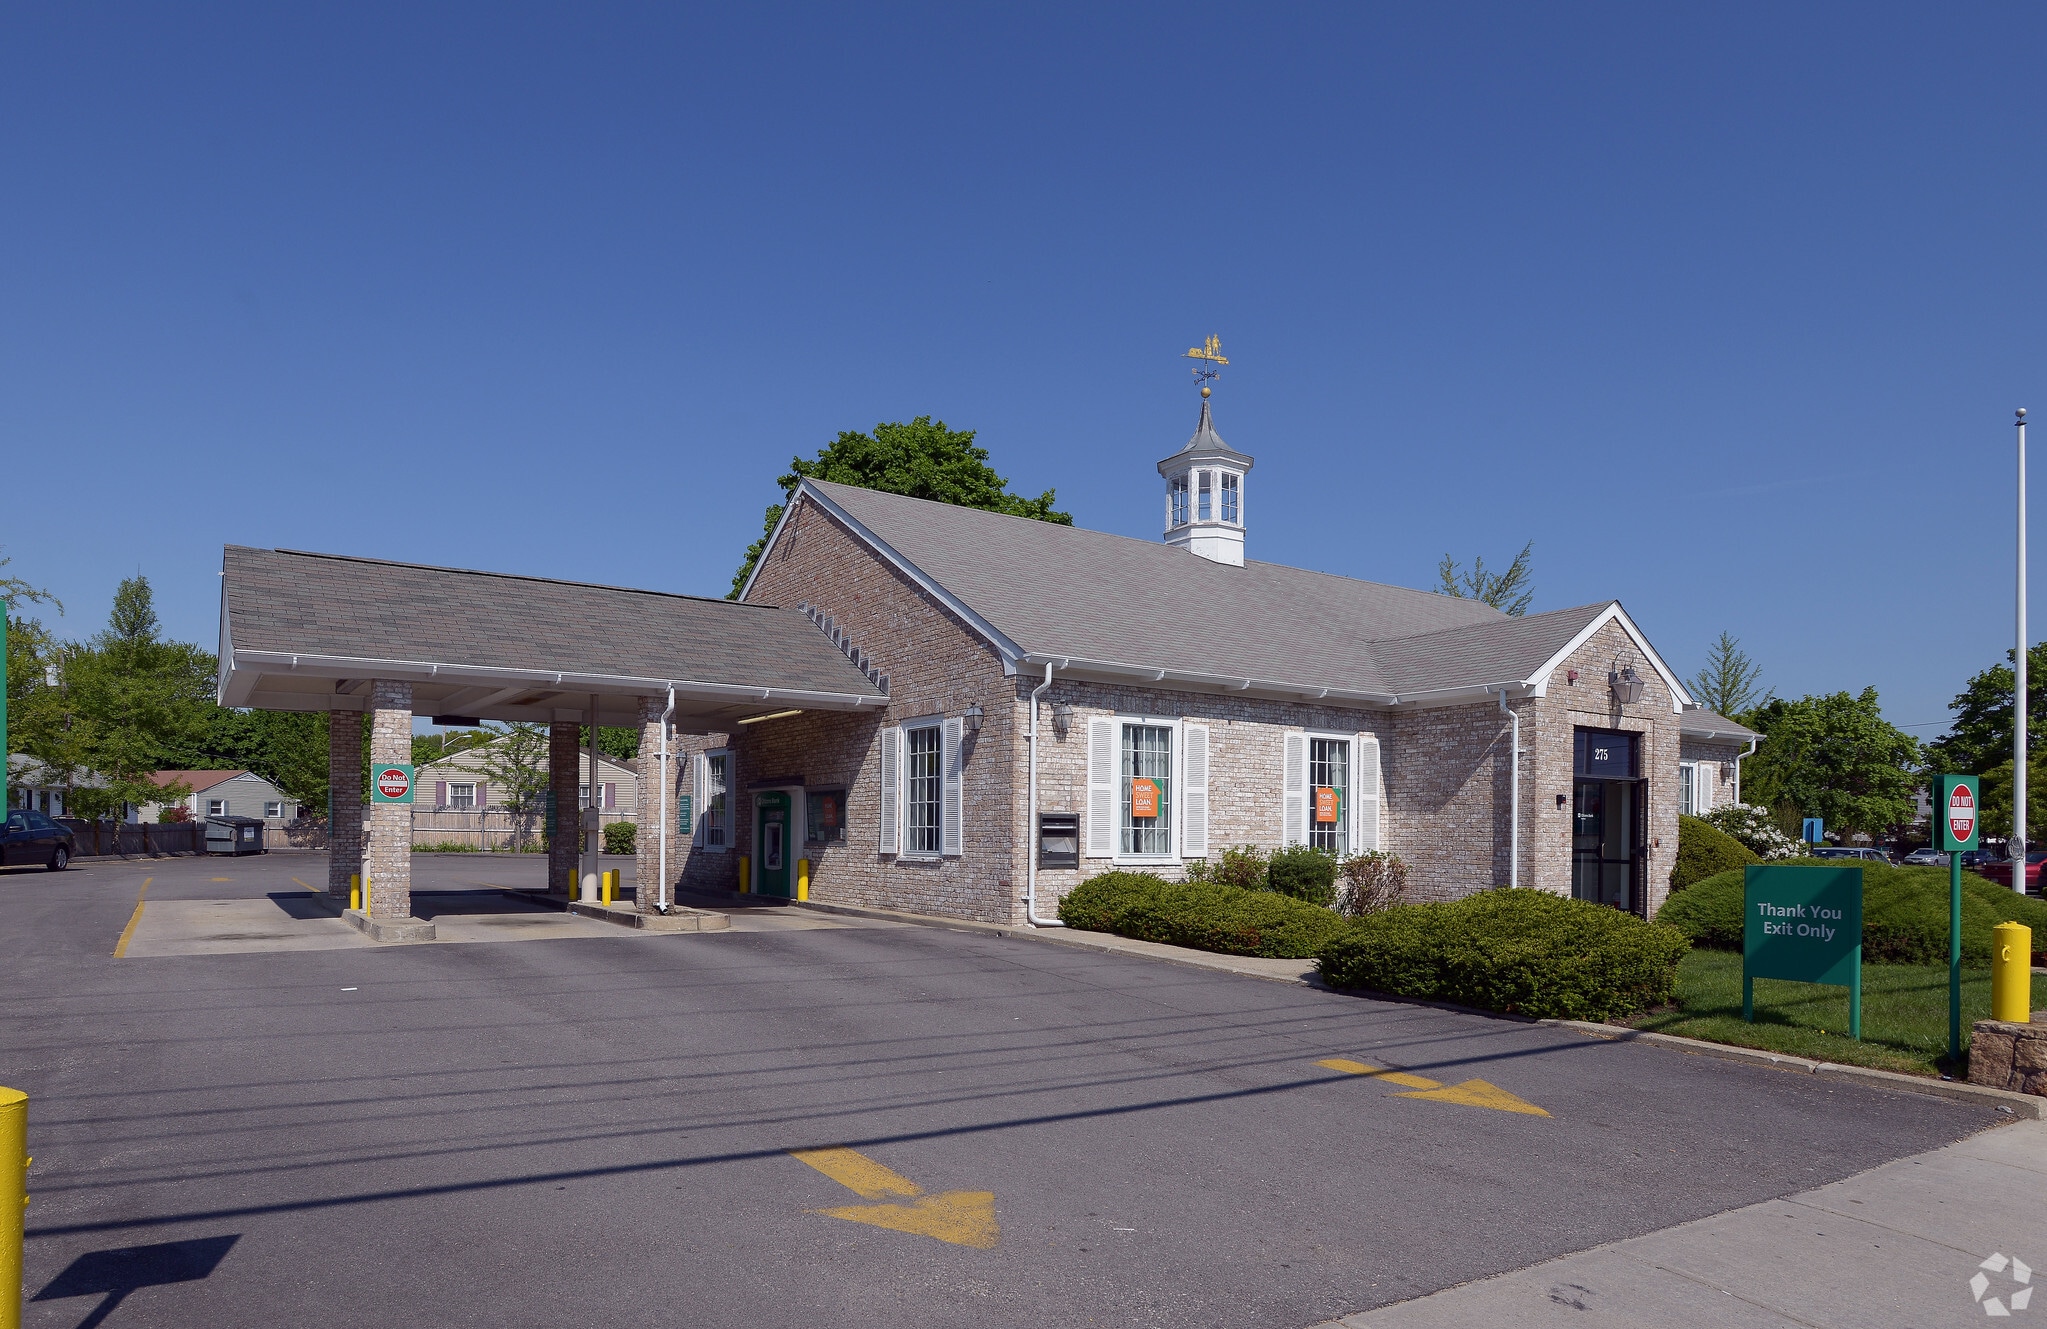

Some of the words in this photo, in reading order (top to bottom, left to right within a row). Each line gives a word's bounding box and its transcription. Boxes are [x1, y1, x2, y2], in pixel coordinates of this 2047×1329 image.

[1594, 748, 1608, 760] 275
[1952, 796, 1960, 806] DO
[1960, 796, 1972, 806] NOT
[1953, 820, 1970, 830] ENTER
[1757, 902, 1806, 918] Thank
[1810, 905, 1842, 920] You
[1763, 921, 1793, 936] Exit
[1796, 924, 1836, 942] Only
